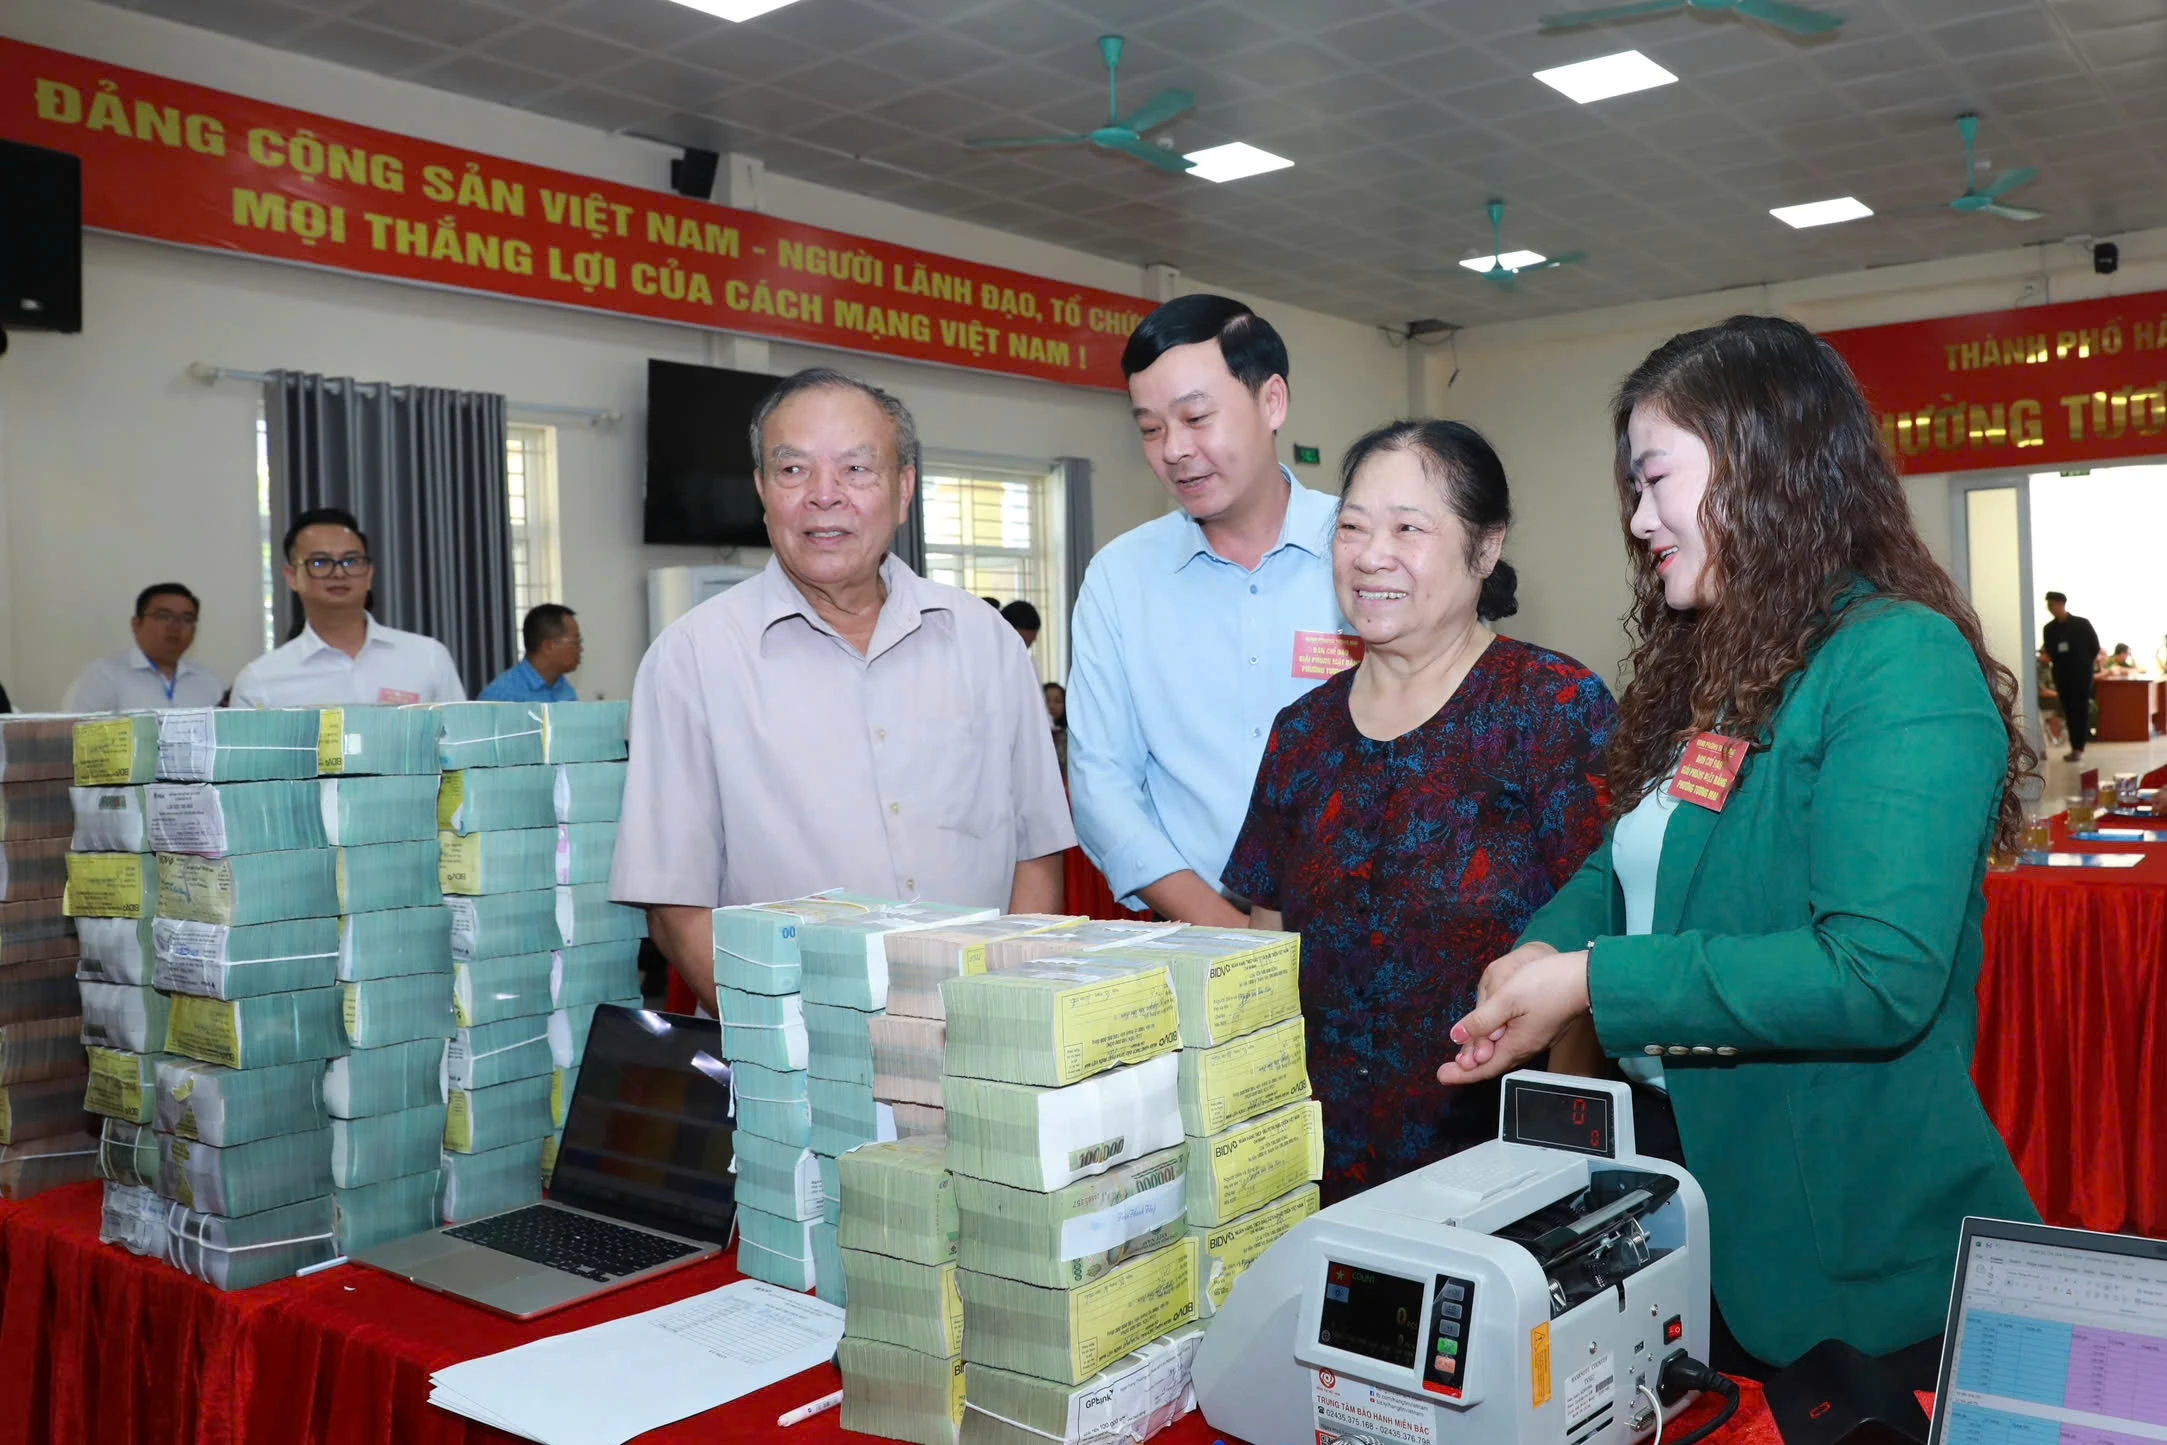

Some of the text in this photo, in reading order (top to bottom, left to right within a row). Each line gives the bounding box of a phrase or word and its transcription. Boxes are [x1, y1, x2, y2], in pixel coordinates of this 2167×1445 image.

[35, 78, 225, 157] ĐẢNG
[247, 127, 405, 193] CỘNG
[423, 161, 526, 217] SẢN
[540, 189, 634, 240] VIỆT
[647, 212, 740, 258] NAM
[779, 239, 884, 288] NGƯỜI
[893, 261, 973, 304] LÃNH
[980, 284, 1043, 323] ĐẠO,
[1050, 294, 1082, 328] TỔ
[1089, 307, 1142, 338] CHỨ
[233, 187, 1087, 371] MỌI THẮNG LỢI CỦA CÁCH MẠNG VIỆT NAM !
[1945, 330, 2048, 372] THÀNH
[2057, 315, 2123, 360] PHỐ
[1210, 966, 1226, 979] BIDV
[1572, 1099, 1586, 1125] 0
[1590, 1130, 1600, 1147] 0
[1216, 1144, 1233, 1157] BIDV
[1209, 1234, 1229, 1249] BIDV
[1396, 1307, 1408, 1326] 0
[1317, 1395, 1430, 1436] TRUNG TÂM BẢO HÀNH MIỀN BẮC
[1326, 1409, 1374, 1431] 02435.375.168
